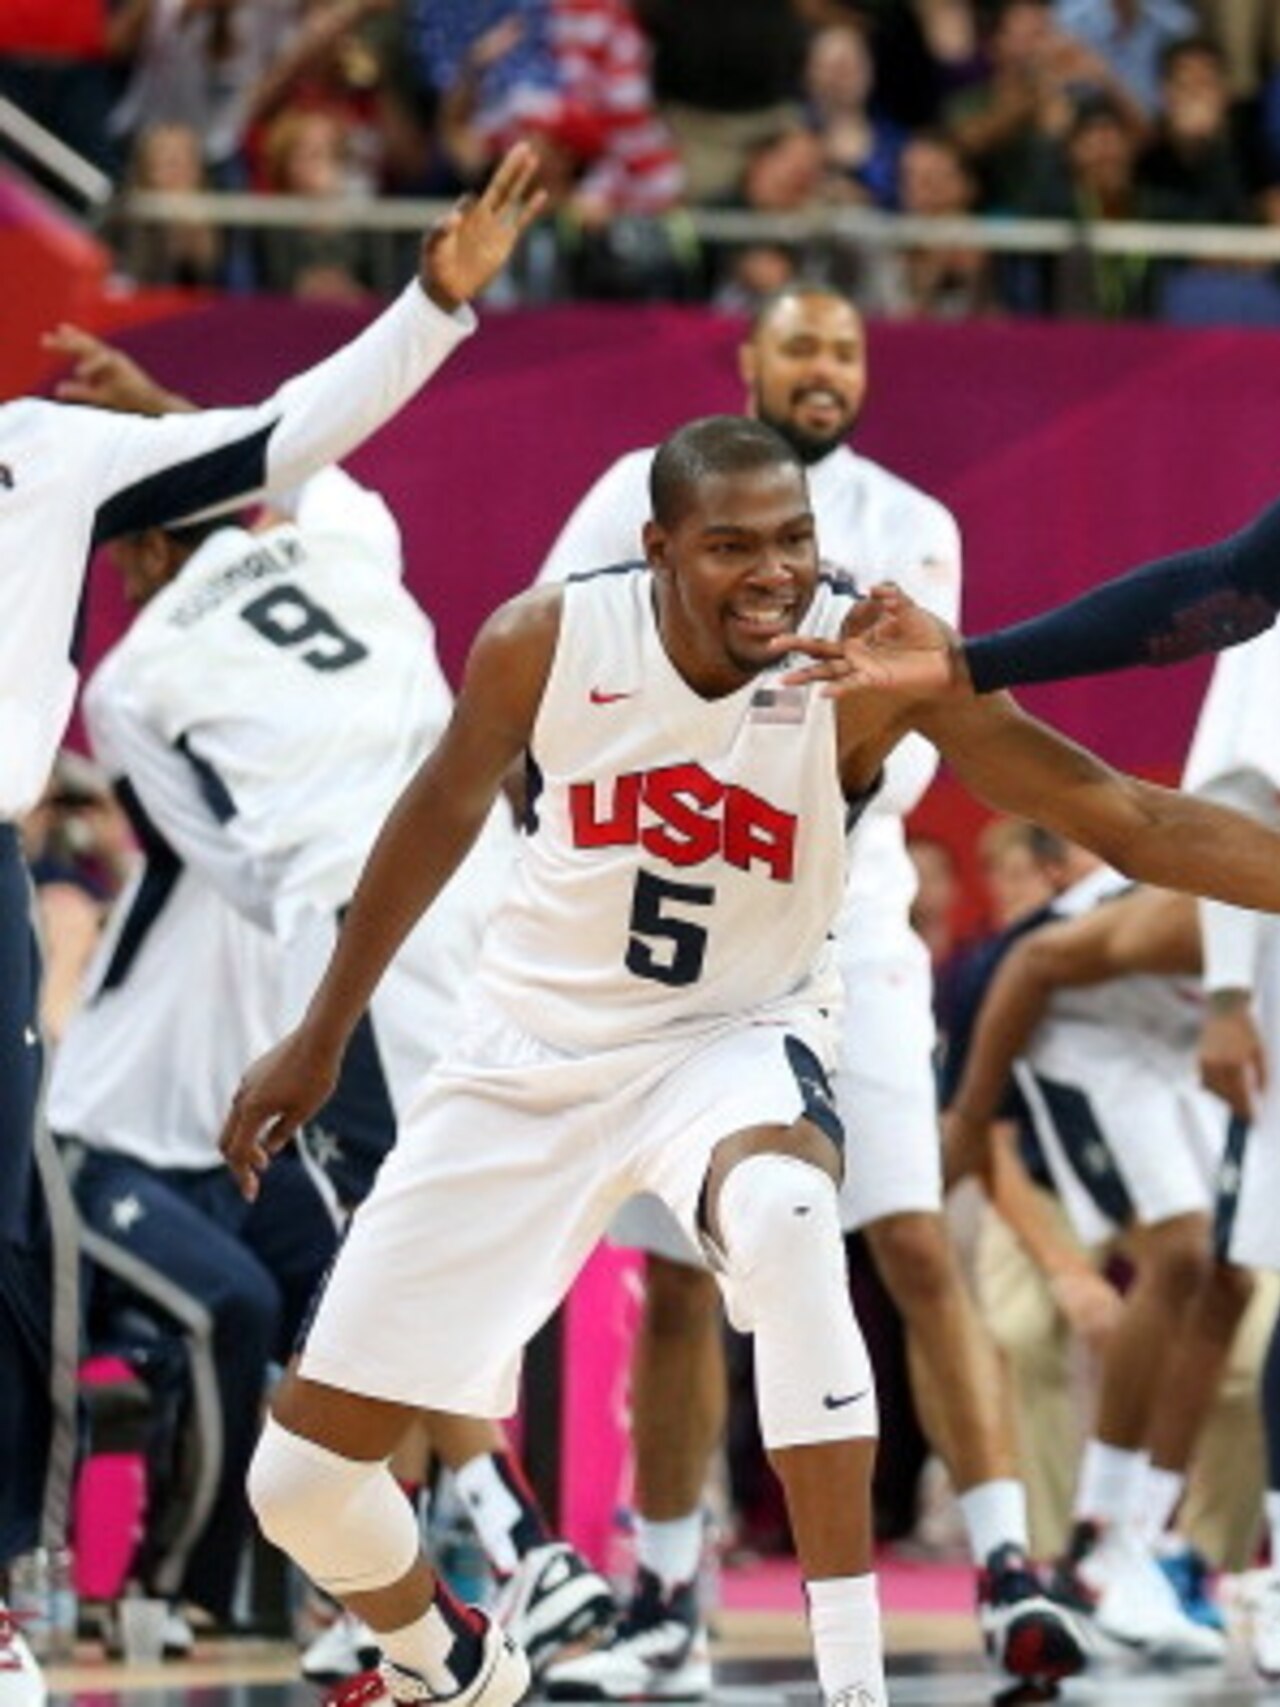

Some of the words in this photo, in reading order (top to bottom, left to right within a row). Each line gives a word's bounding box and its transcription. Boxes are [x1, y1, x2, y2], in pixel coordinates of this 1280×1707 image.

[241, 585, 368, 669] 9
[567, 761, 800, 883] USA
[624, 869, 716, 988] 5
